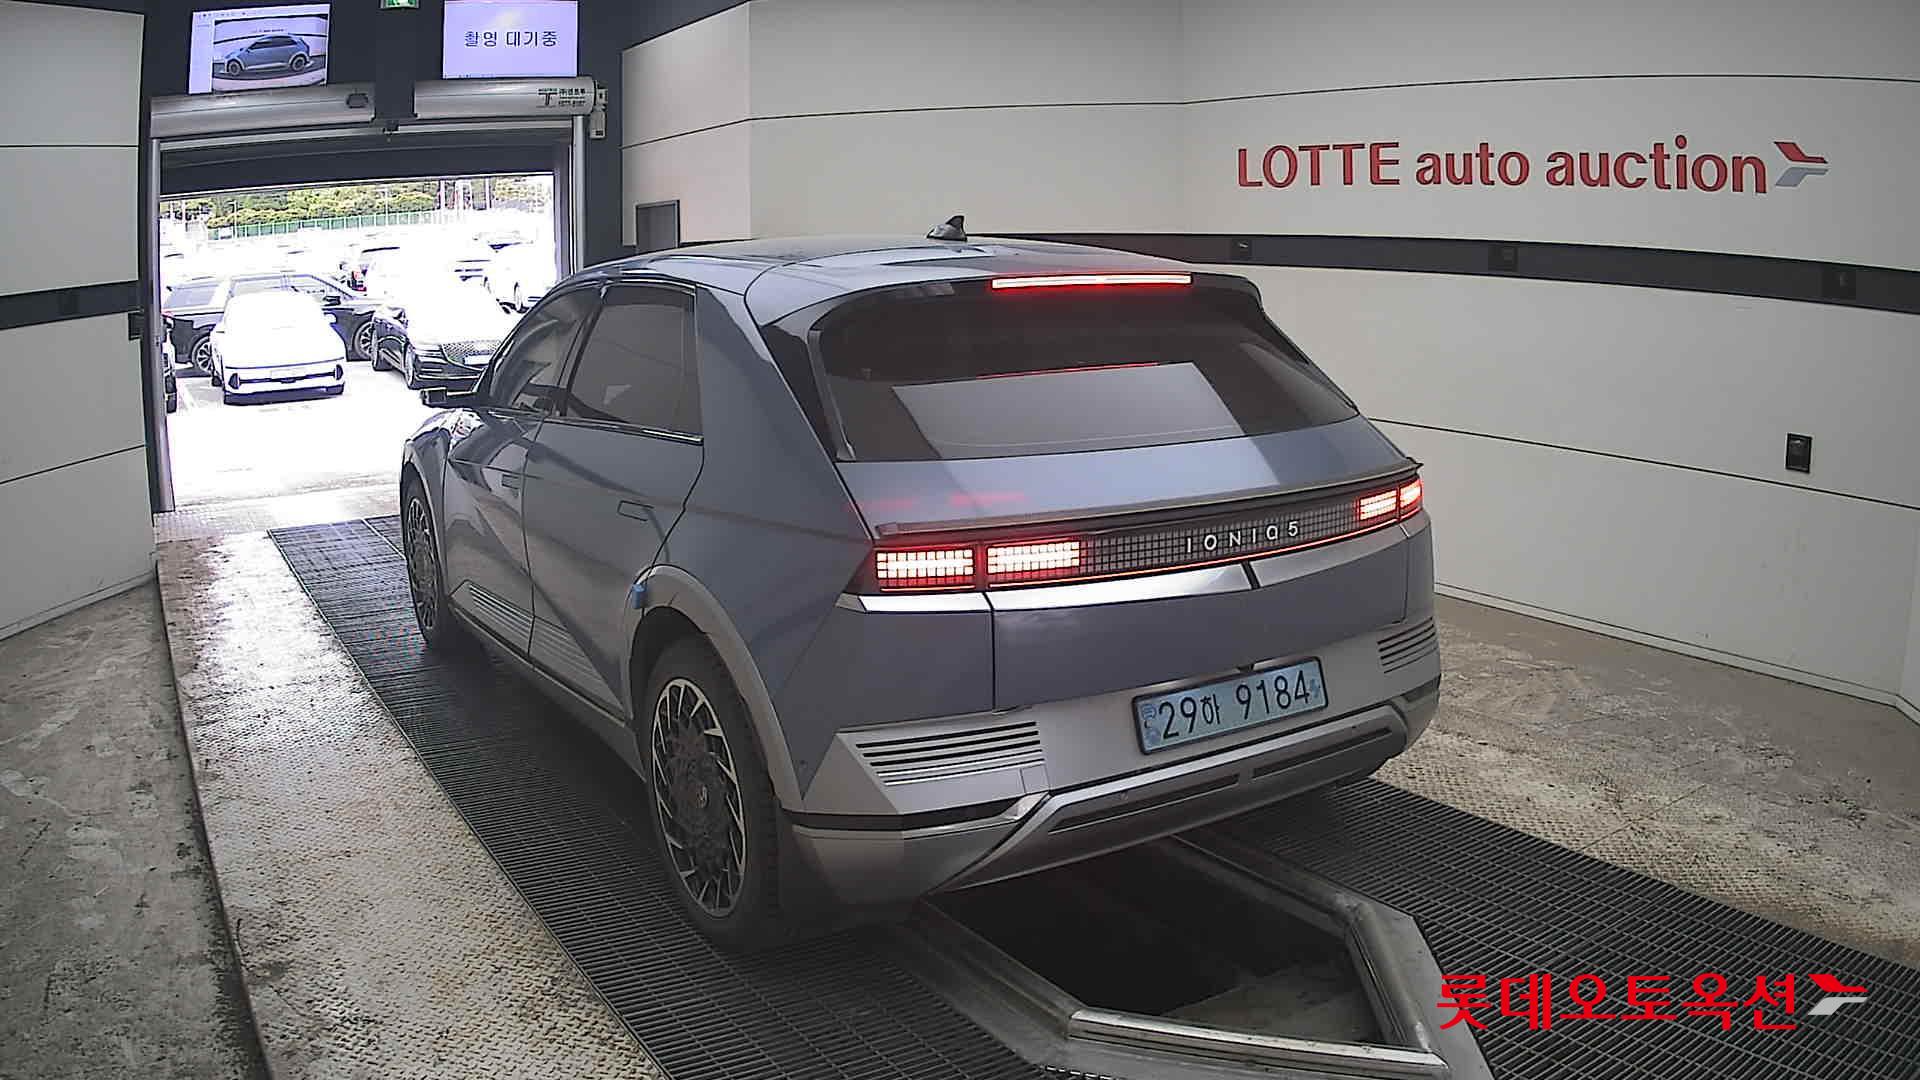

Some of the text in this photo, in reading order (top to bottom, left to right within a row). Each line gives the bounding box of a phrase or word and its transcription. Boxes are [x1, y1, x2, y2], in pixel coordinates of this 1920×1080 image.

[463, 31, 558, 47] 촬영 대기중
[1238, 134, 1767, 194] LOTTE auto auction
[1158, 669, 1311, 740] 29하 9184
